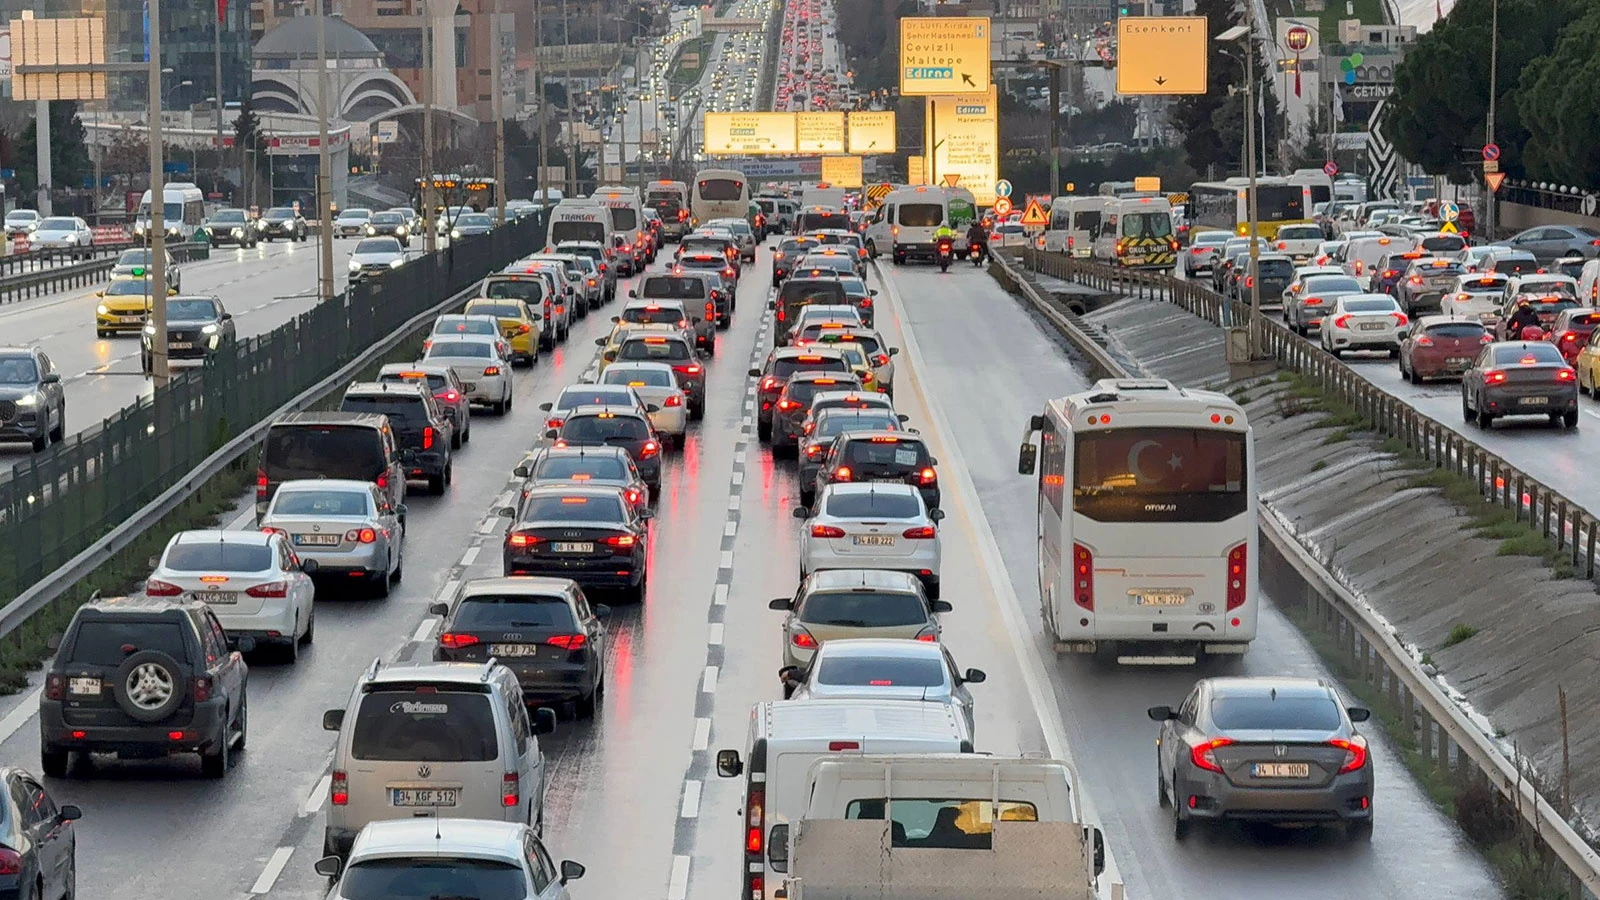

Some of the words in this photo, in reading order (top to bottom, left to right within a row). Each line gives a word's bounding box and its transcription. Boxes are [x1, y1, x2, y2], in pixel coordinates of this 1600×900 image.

[1126, 24, 1191, 33] Esenkent
[906, 43, 954, 52] Cevizli
[906, 56, 963, 67] Maltepe
[906, 68, 952, 78] Edirne
[957, 106, 986, 114] Edirne
[560, 213, 596, 222] TRANSAY
[1128, 246, 1146, 254] OKUL
[1144, 504, 1177, 512] OTOKAR
[491, 644, 500, 654] 35
[522, 644, 535, 654] 734
[1257, 763, 1267, 775] 34
[1272, 763, 1282, 775] TC
[399, 791, 411, 802] 34
[415, 791, 432, 802] KGF
[437, 791, 454, 802] 512
